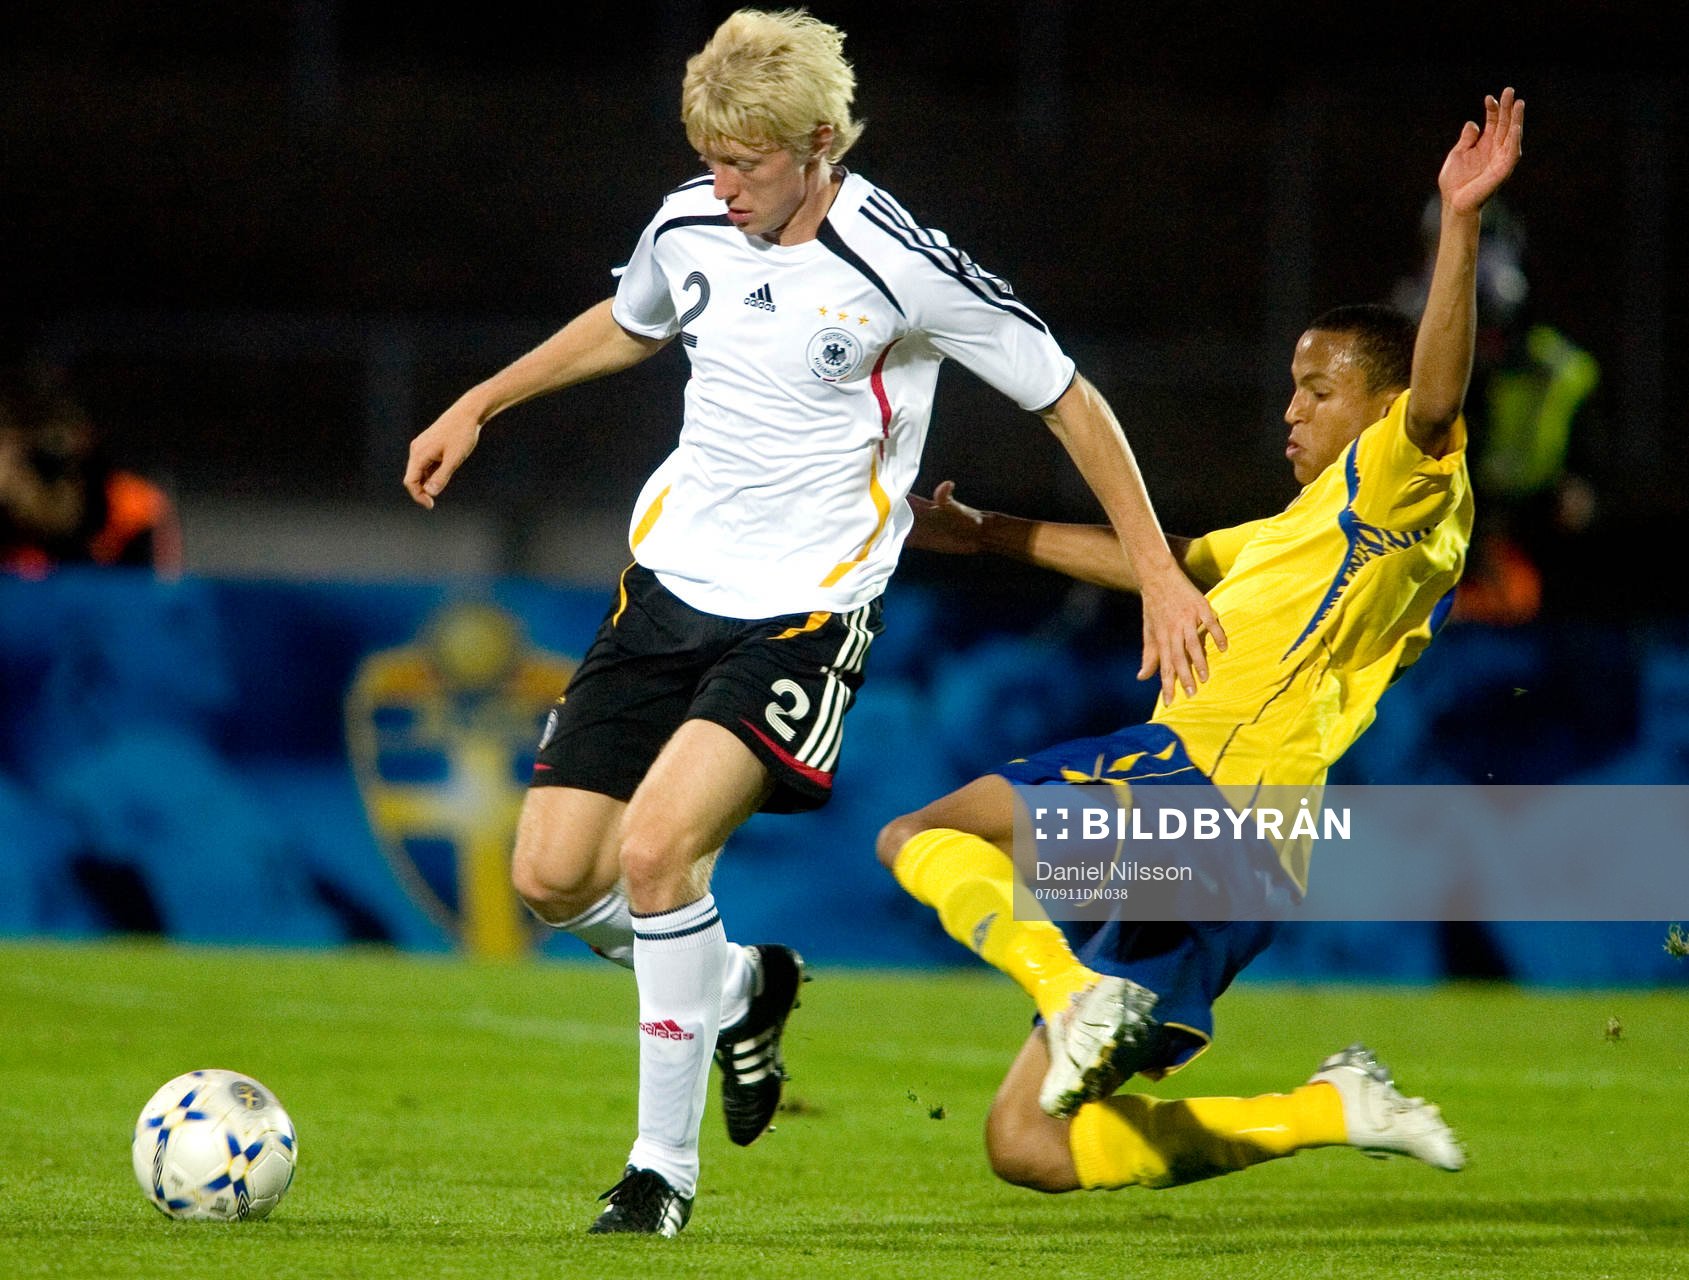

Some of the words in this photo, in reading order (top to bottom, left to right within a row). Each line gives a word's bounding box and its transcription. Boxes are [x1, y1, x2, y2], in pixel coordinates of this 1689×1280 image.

[679, 270, 711, 348] 2
[744, 297, 776, 312] adidas
[765, 678, 810, 742] 2
[639, 1022, 694, 1040] adidas
